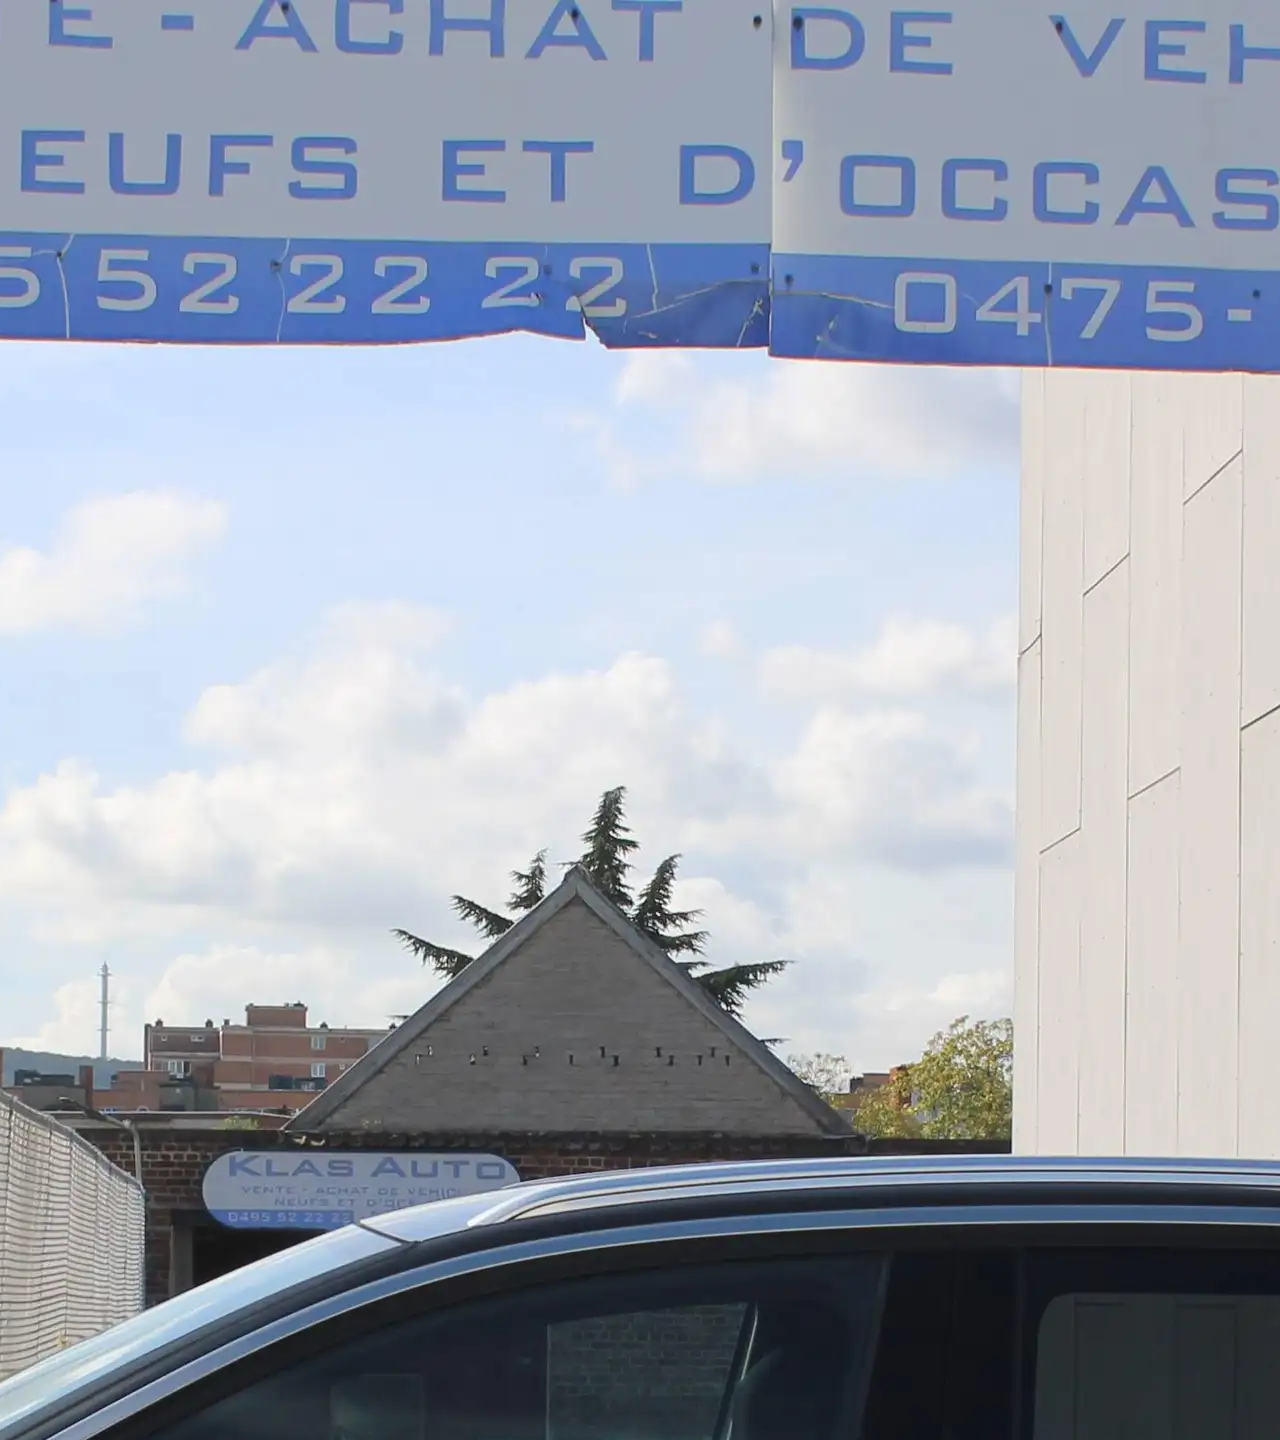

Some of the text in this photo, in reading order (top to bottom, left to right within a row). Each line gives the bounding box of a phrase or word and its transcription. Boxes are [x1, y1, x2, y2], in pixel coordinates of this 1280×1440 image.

[236, 0, 683, 60] ACHAT
[790, 6, 953, 73] DE
[442, 138, 594, 202] ET
[97, 248, 239, 313] 52
[286, 253, 430, 313] 22
[481, 256, 627, 318] 22
[228, 1155, 506, 1180] KLAS AUTO
[241, 1185, 296, 1195] VENTE
[315, 1186, 370, 1196] ACHAT
[377, 1187, 400, 1196] DE
